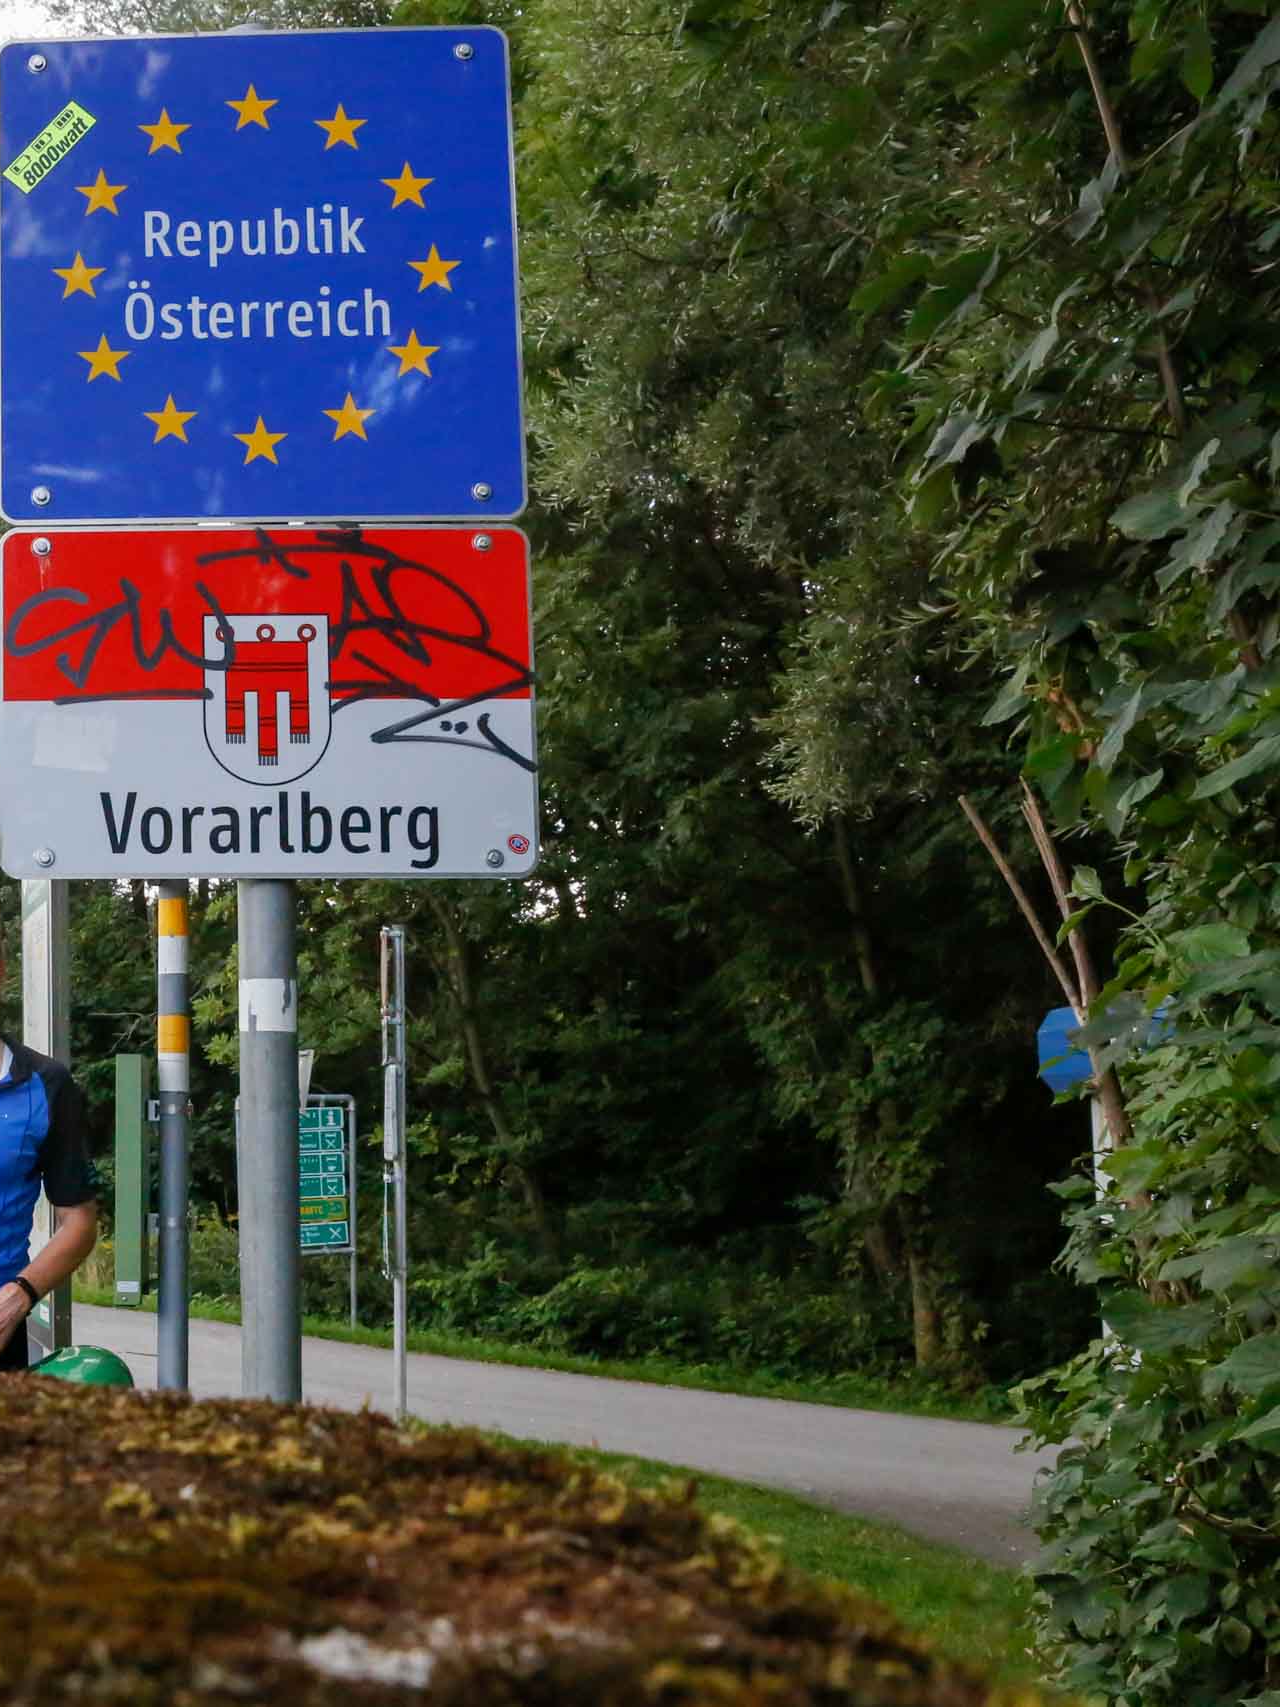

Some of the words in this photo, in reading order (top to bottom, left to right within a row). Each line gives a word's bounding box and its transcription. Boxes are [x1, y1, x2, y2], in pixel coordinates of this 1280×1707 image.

[23, 117, 89, 187] 8000watt
[143, 203, 366, 268] Republik
[124, 280, 391, 341] Österreich
[99, 791, 440, 870] Vorarlberg
